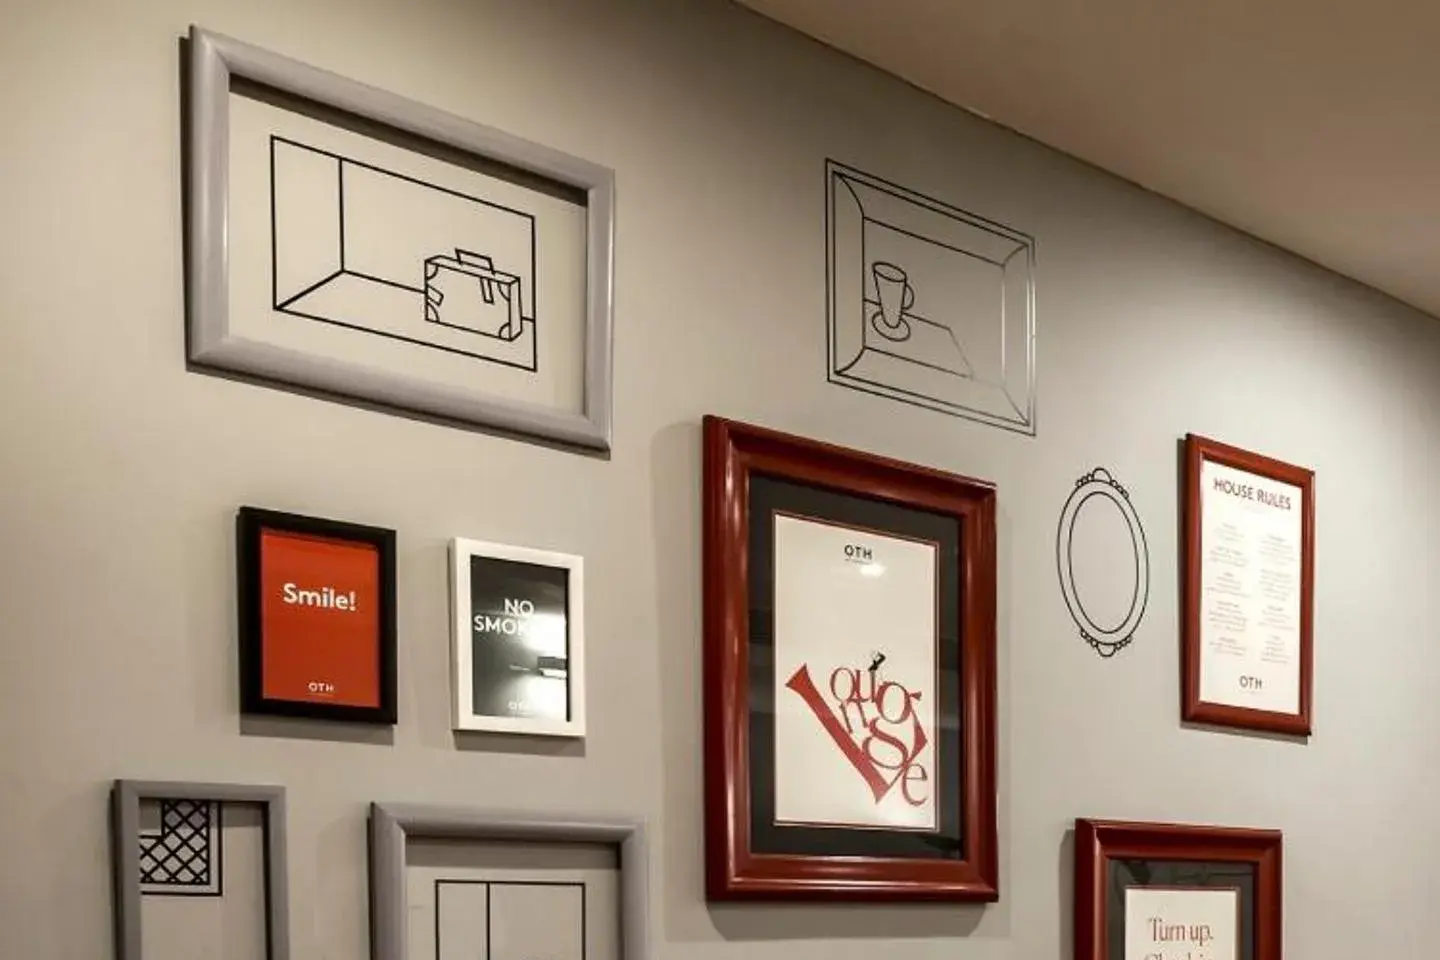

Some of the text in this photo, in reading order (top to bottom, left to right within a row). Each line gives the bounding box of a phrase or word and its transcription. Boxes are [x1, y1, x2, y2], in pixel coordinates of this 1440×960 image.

[1213, 477, 1292, 511] HOUSE RULES
[844, 544, 872, 560] OTH
[283, 582, 356, 612] Smile!
[504, 598, 534, 617] NO
[308, 682, 335, 692] OTH
[1239, 675, 1263, 690] OTH
[1147, 916, 1214, 947] Turn up.
